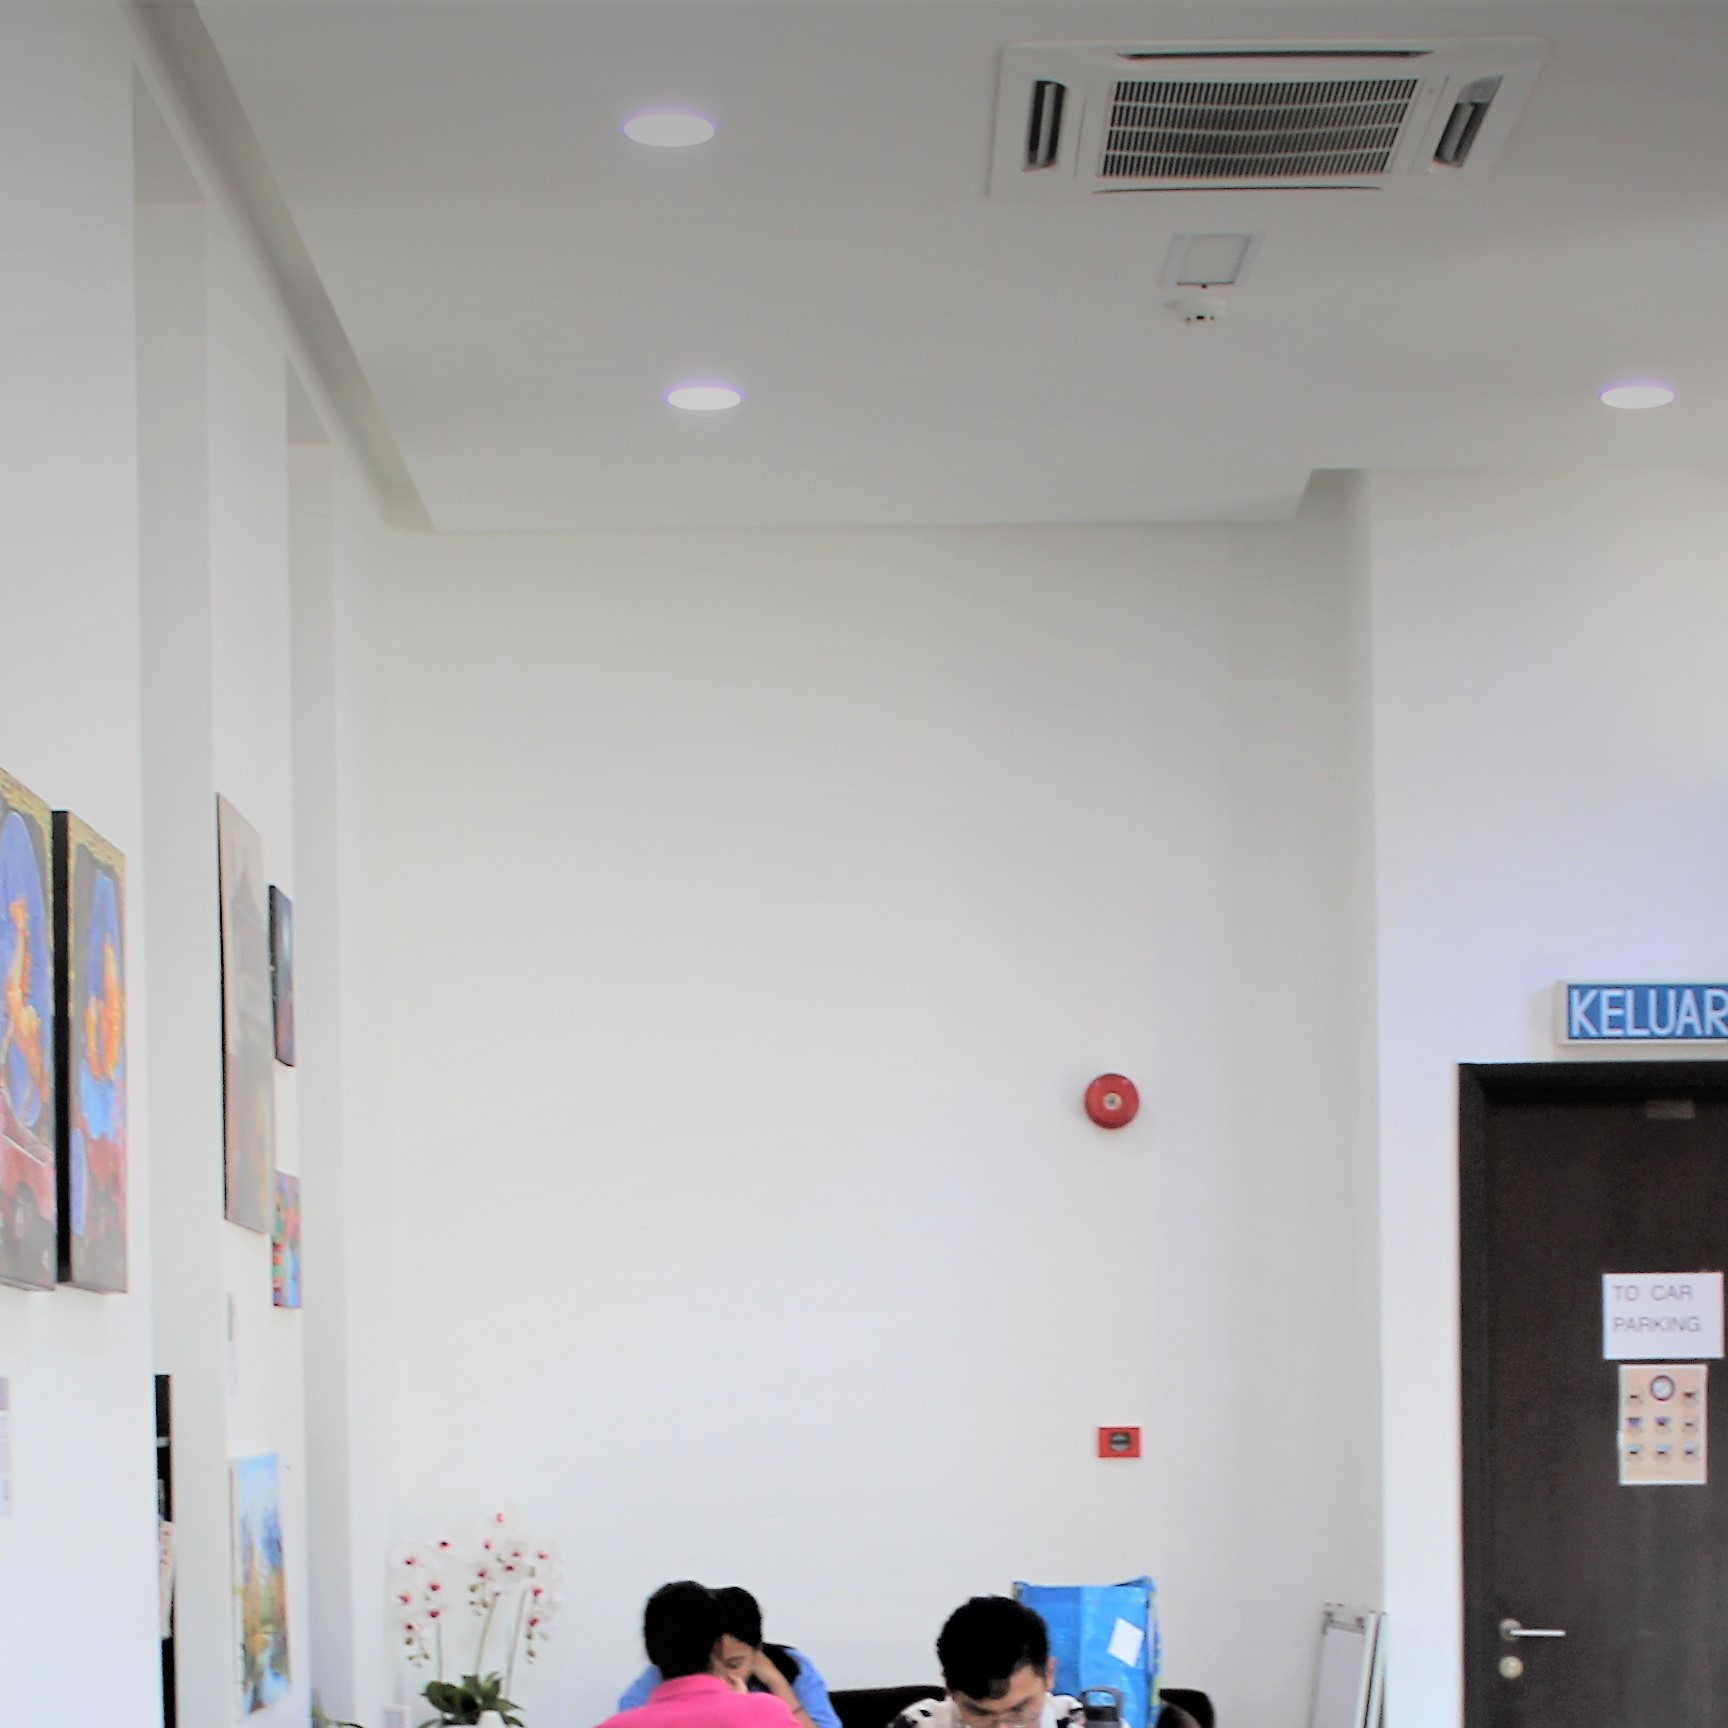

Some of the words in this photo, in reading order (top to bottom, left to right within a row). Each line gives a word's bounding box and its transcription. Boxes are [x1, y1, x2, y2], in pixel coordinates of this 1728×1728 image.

[1613, 1284, 1640, 1301] TO
[1651, 1284, 1694, 1301] CAR
[1613, 1316, 1702, 1332] PARKING
